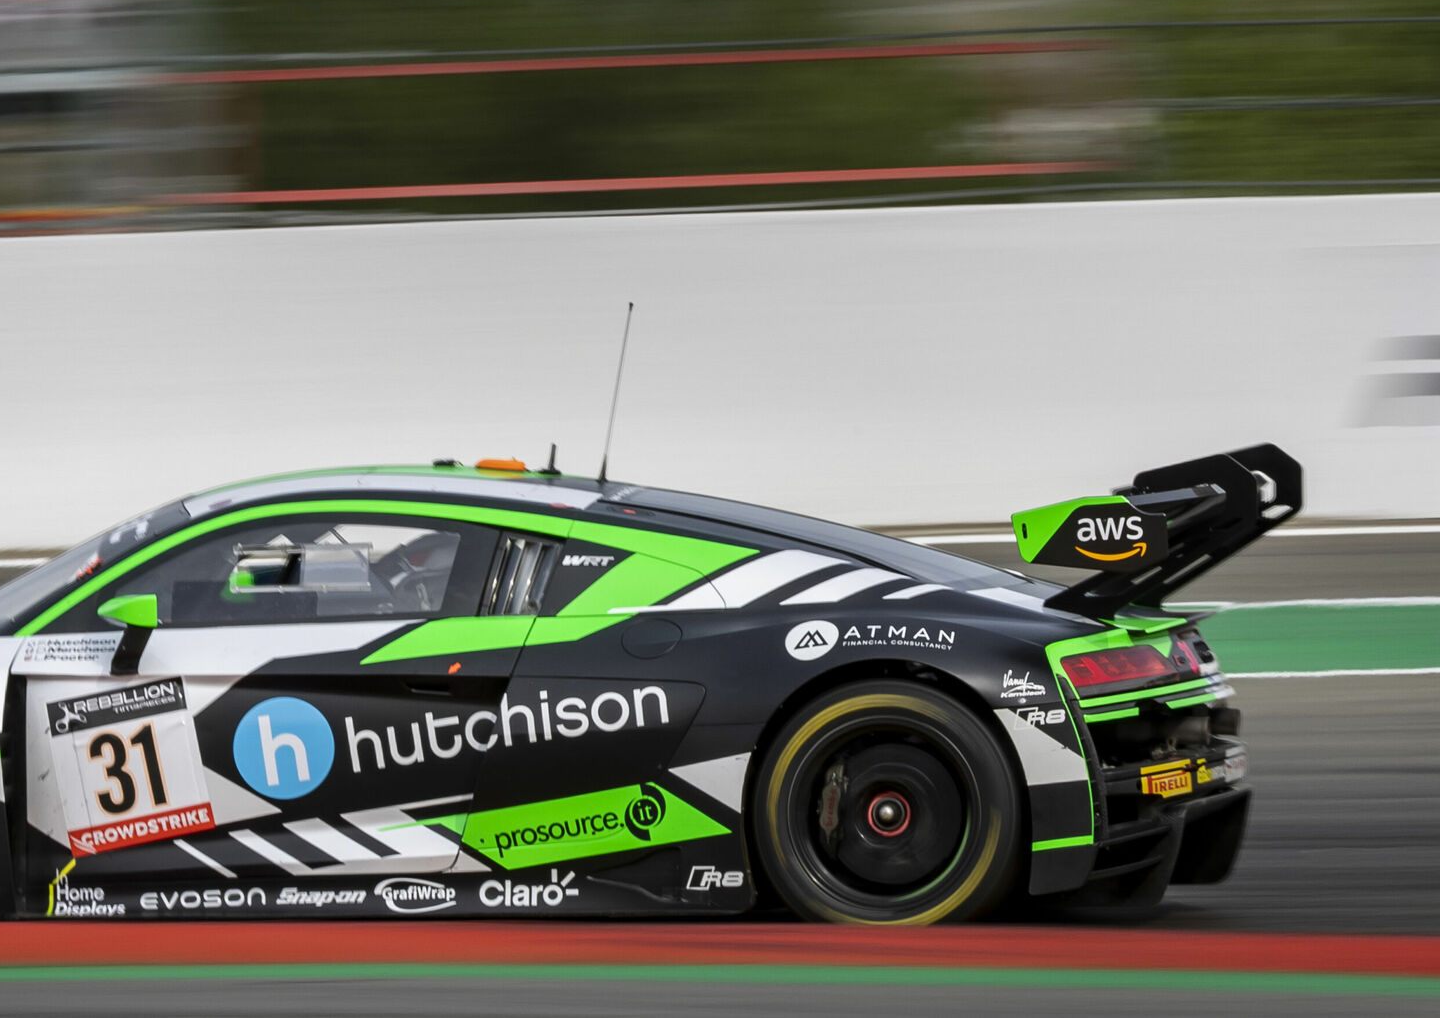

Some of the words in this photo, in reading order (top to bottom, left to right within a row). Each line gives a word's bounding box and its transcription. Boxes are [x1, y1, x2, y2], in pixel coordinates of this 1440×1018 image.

[1077, 516, 1144, 542] aws
[562, 555, 614, 566] WRT
[844, 625, 955, 644] ATMAN
[891, 639, 952, 651] CONSULTANCY
[73, 682, 175, 713] REBELLION
[1027, 709, 1066, 725] R8
[345, 686, 669, 773] hutchison
[258, 715, 310, 786] h
[88, 721, 169, 815] 31
[80, 807, 211, 847] CROWDSTRIKE
[700, 870, 744, 887] R8
[56, 884, 105, 902] Home
[276, 887, 367, 907] Snap-on
[382, 885, 456, 902] GrafiWrap
[479, 879, 564, 907] Claro
[54, 900, 126, 917] Displays
